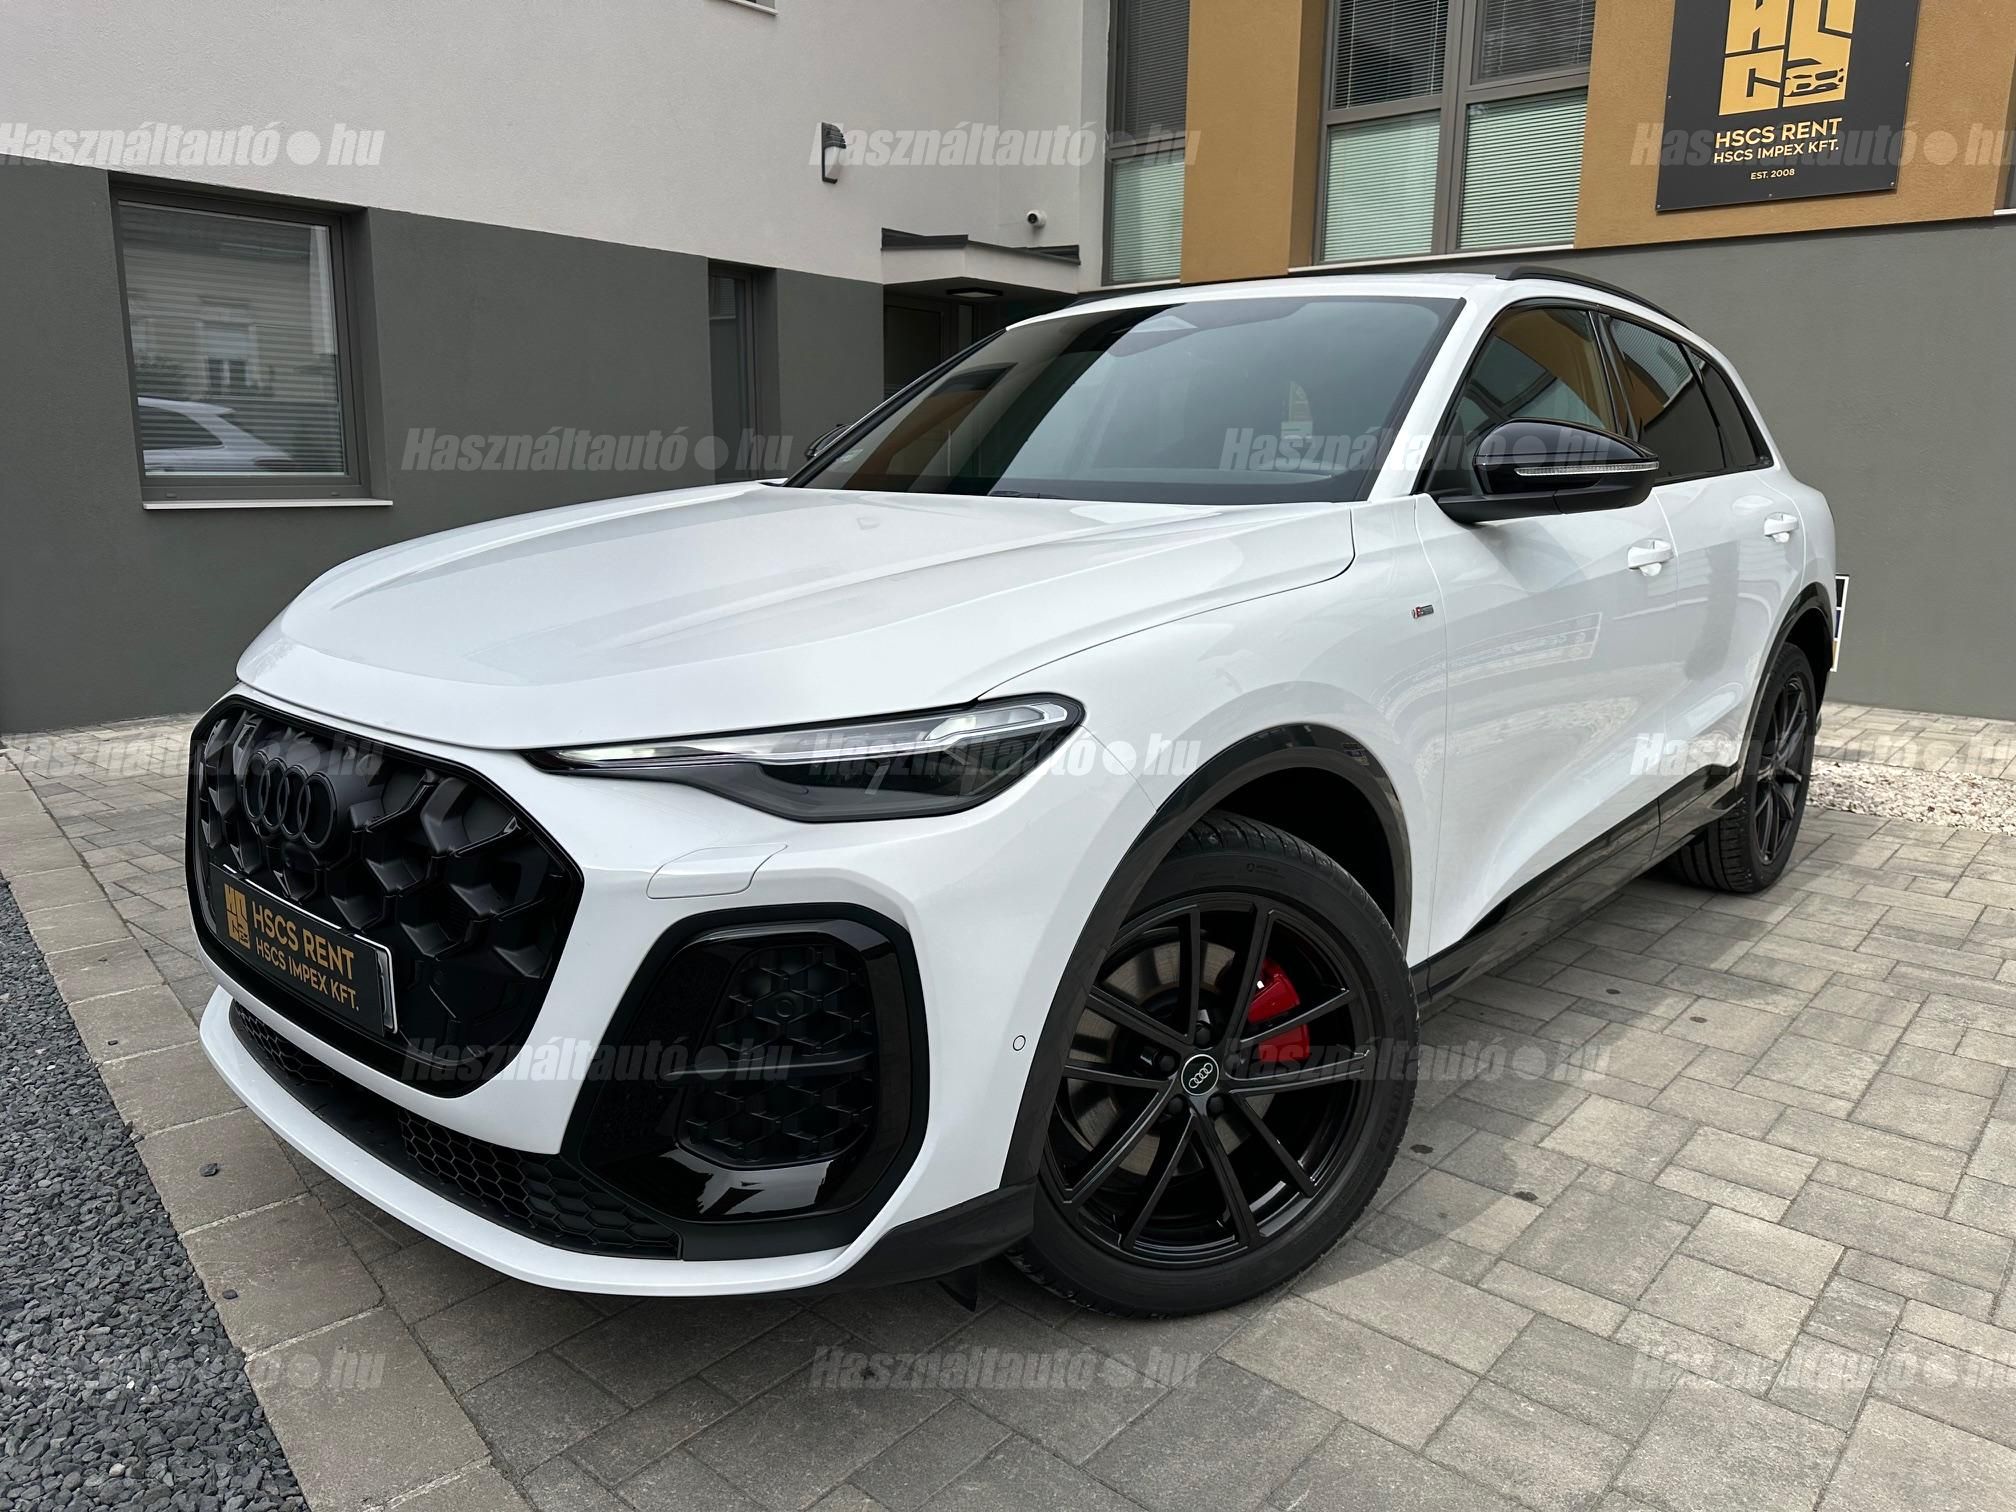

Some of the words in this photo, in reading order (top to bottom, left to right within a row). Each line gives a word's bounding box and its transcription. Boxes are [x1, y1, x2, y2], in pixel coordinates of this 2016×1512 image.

[1715, 126, 1775, 148] HSCS
[1781, 117, 1843, 141] RENT
[1713, 148, 1753, 164] HSCS
[1757, 143, 1805, 159] IMPEX
[1808, 138, 1839, 153] KFT.
[1750, 170, 1768, 180] EST.
[1770, 168, 1795, 178] 2008
[252, 900, 299, 951] HSCS
[302, 927, 354, 980] RENT
[255, 936, 286, 971] HSCS
[288, 955, 328, 995] IMPEX
[330, 978, 359, 1011] KFT.
